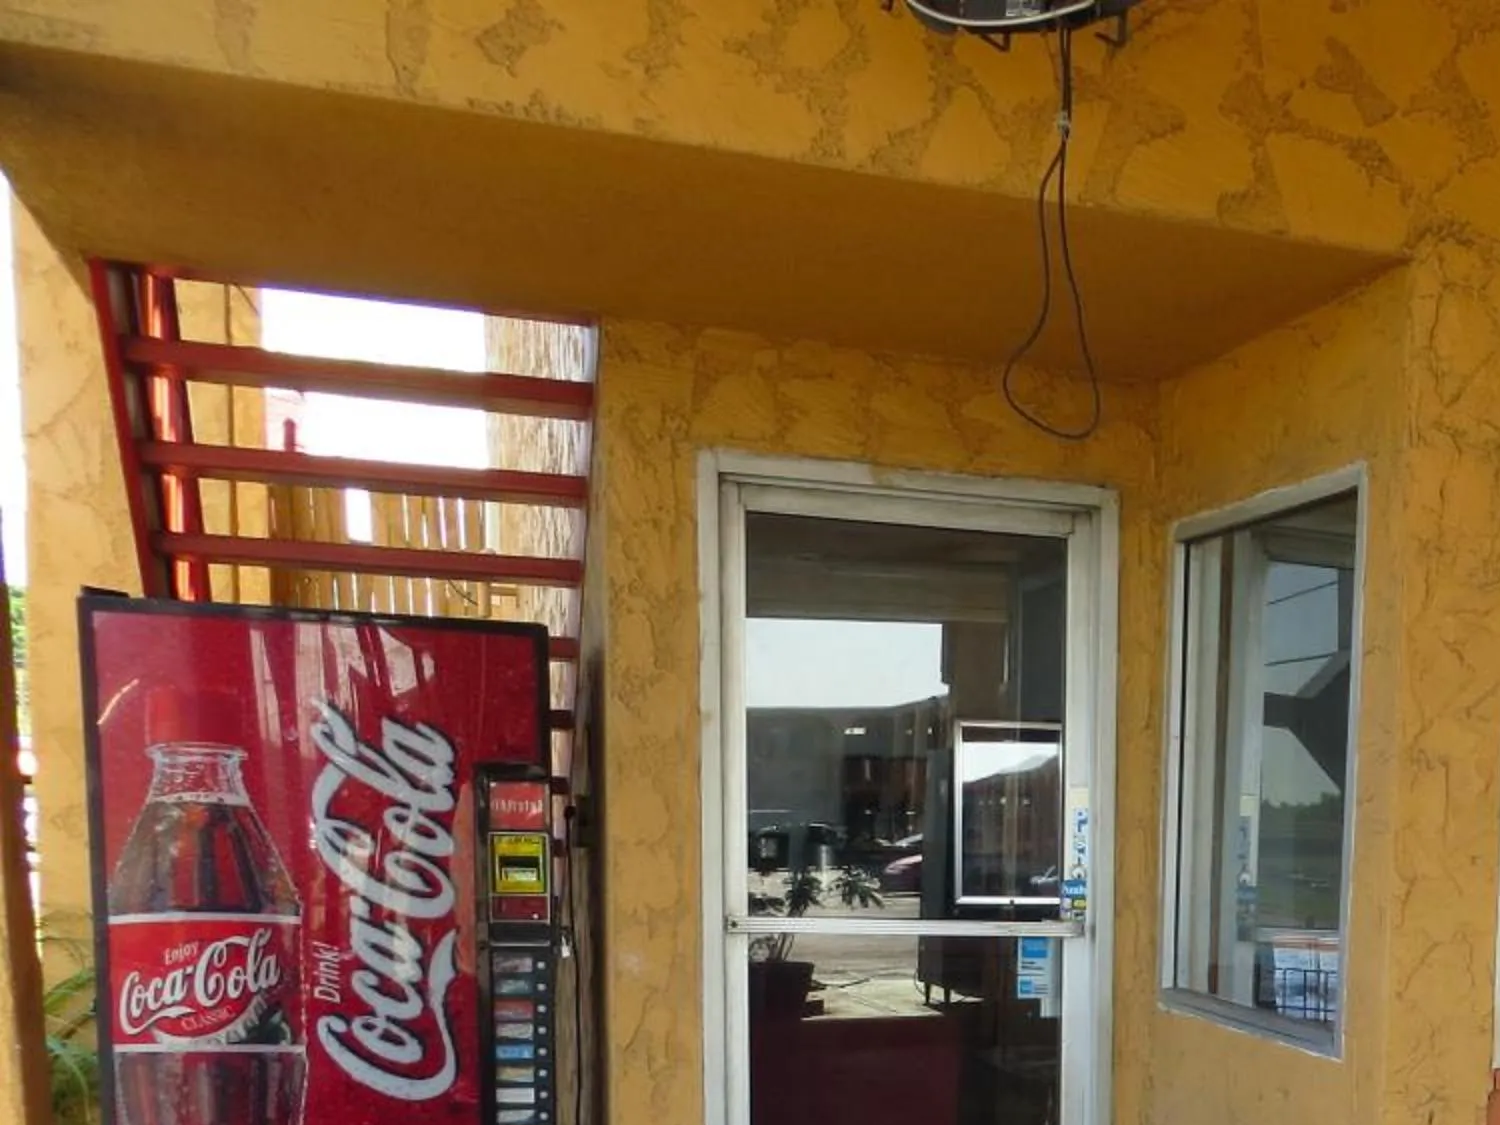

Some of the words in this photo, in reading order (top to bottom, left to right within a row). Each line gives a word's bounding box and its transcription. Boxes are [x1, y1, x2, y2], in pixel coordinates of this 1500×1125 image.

[311, 697, 456, 1101] Coca-Cola
[119, 928, 280, 1035] Coca-Cola
[165, 941, 200, 965] Enjoy
[312, 941, 341, 1004] Drink!
